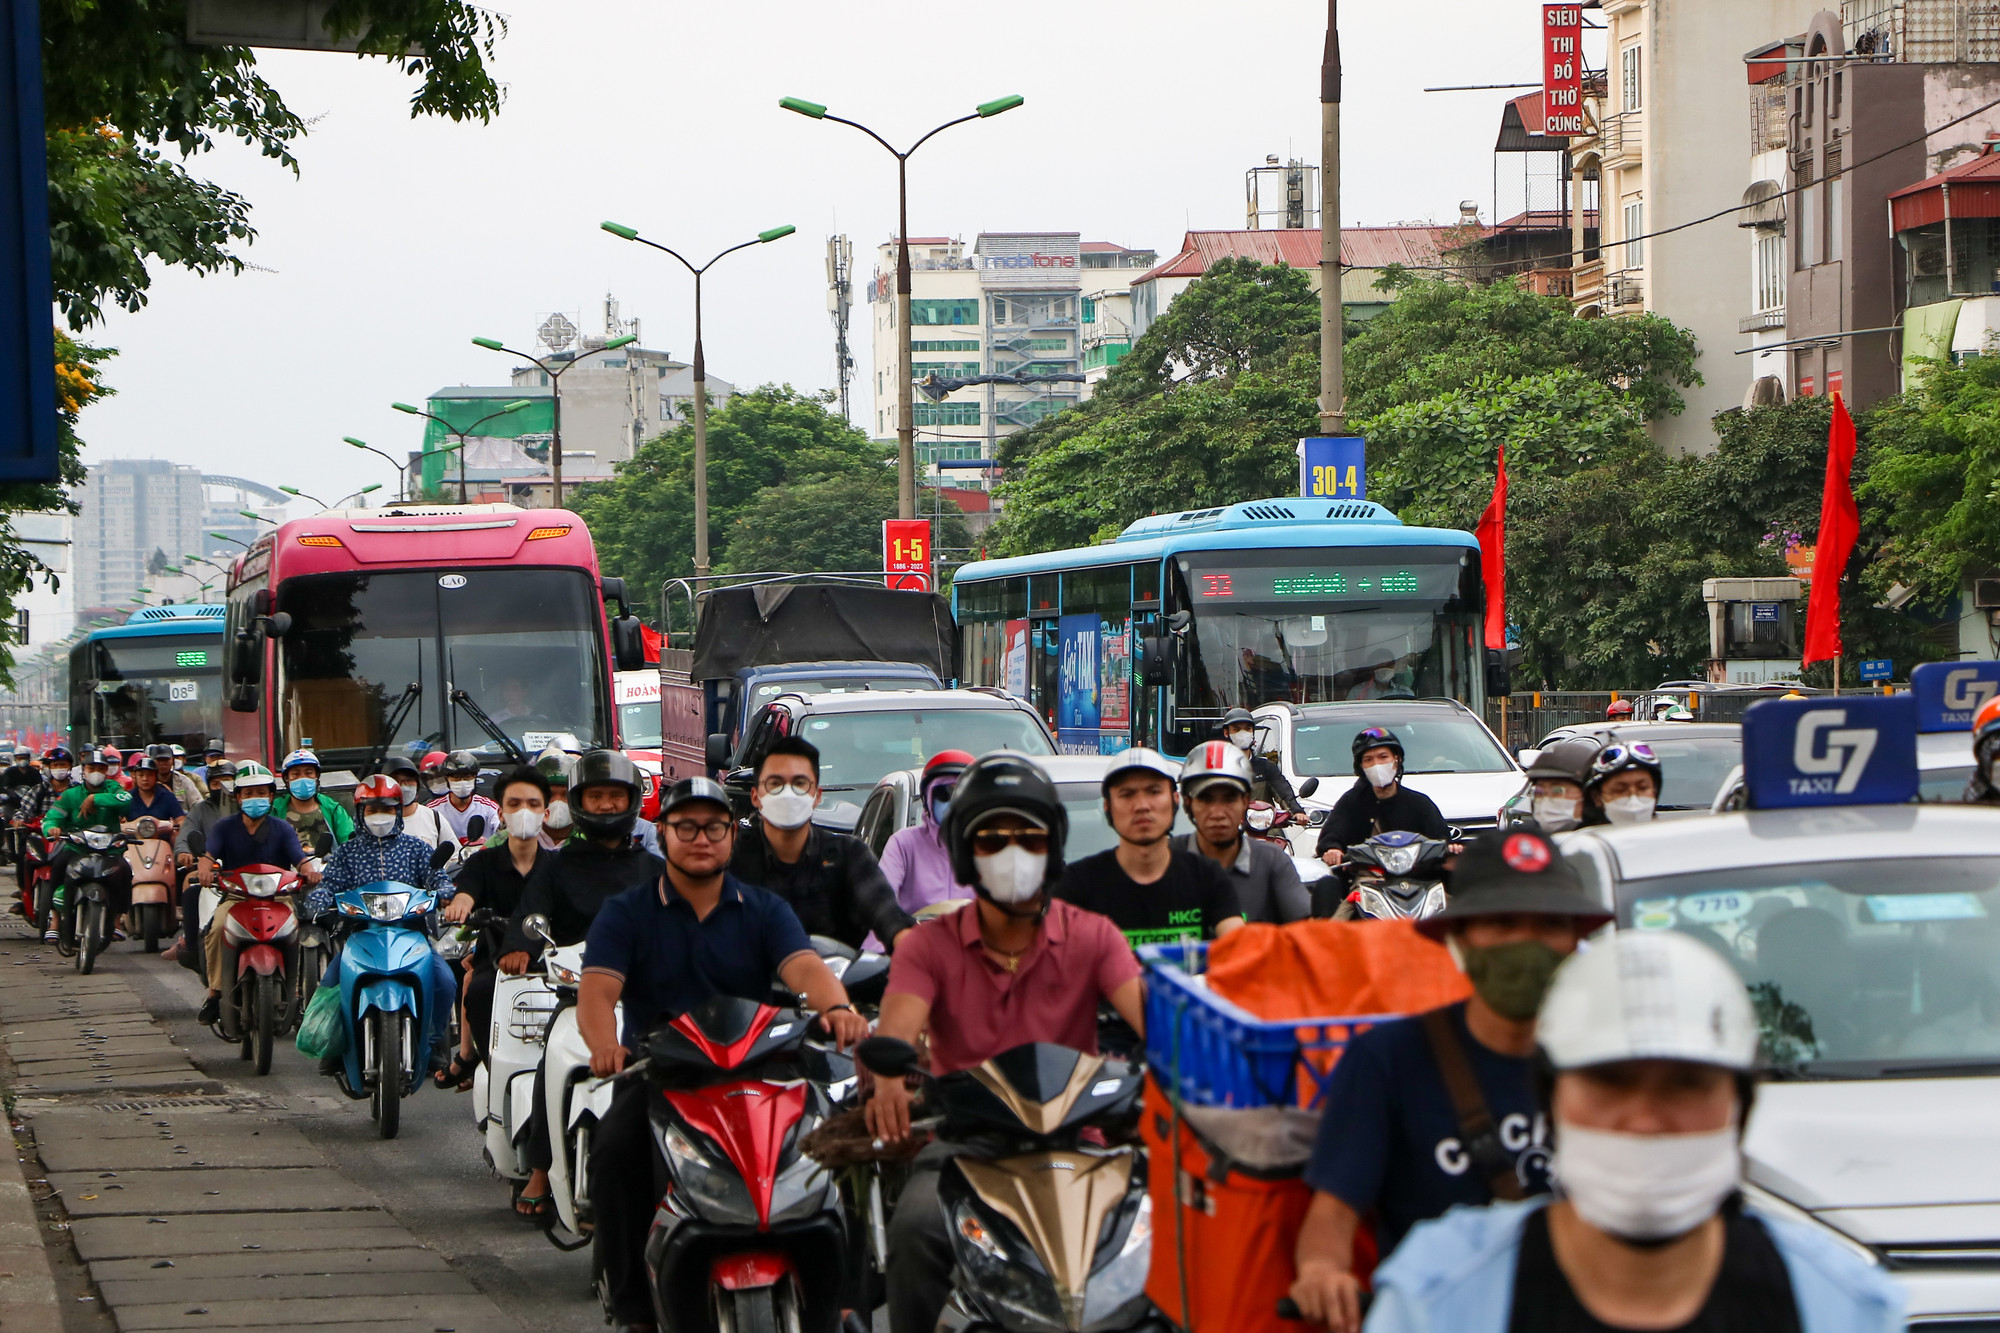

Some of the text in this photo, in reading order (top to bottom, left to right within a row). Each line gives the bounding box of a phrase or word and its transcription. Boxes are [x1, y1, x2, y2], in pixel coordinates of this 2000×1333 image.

[1547, 6, 1577, 26] SIÊU
[1551, 37, 1574, 56] THỊ
[1553, 58, 1573, 80] ĐỒ
[1549, 85, 1578, 106] THỜ
[1546, 112, 1581, 132] CÚNG
[985, 252, 1075, 269] mobifone
[1313, 465, 1358, 496] 30-4
[893, 538, 923, 561] 1-5
[1077, 631, 1095, 689] TAXI
[1941, 712, 1972, 723] TAXI
[1794, 709, 1878, 794] G7
[1789, 778, 1834, 795] TAXI
[1168, 908, 1202, 924] HKC
